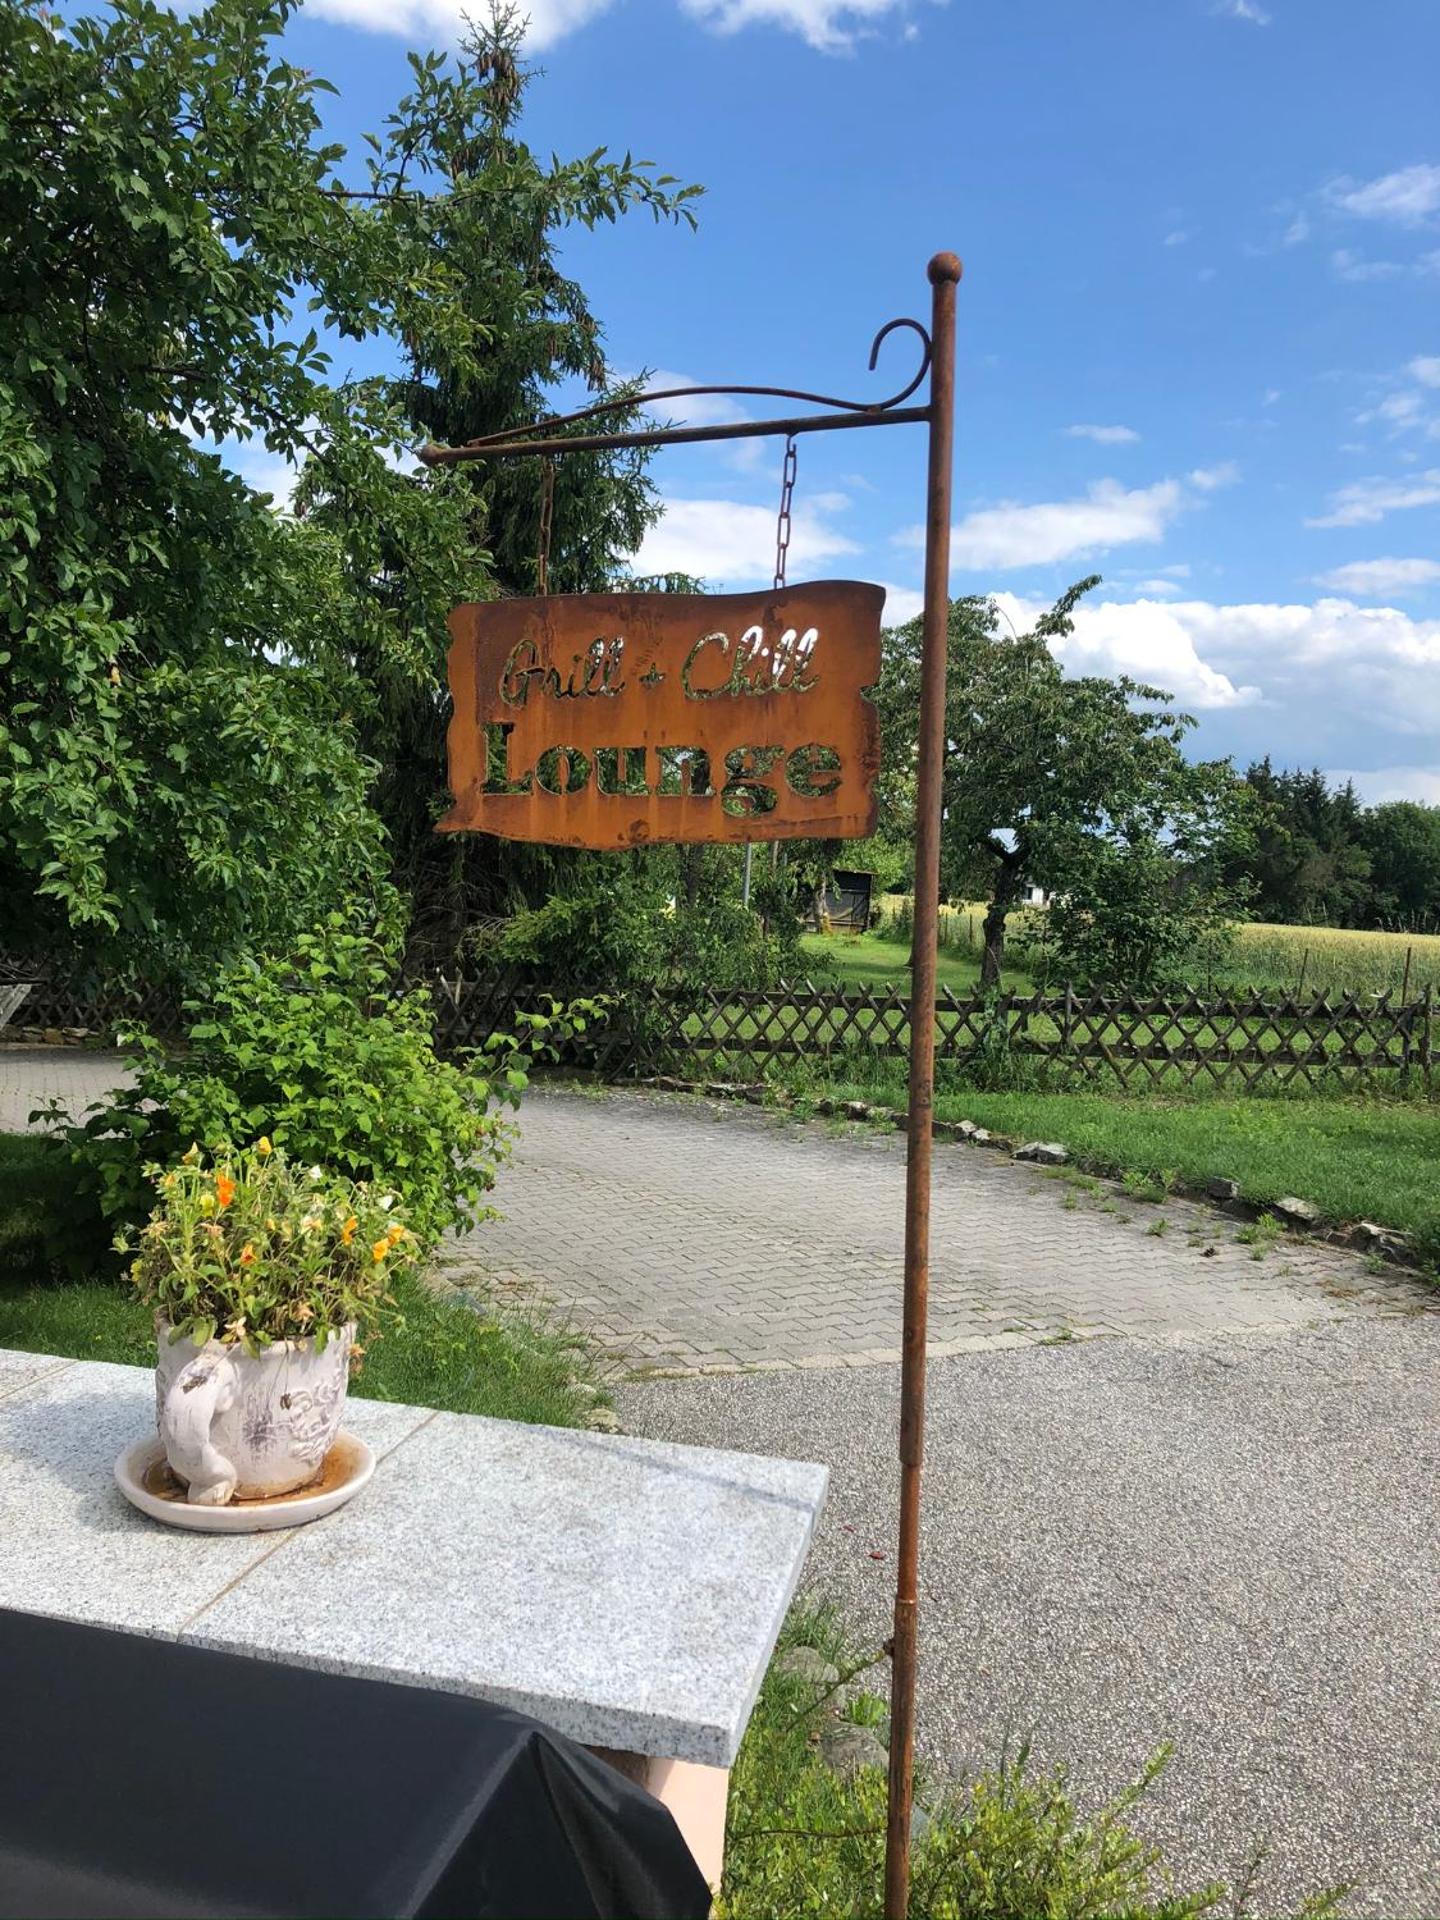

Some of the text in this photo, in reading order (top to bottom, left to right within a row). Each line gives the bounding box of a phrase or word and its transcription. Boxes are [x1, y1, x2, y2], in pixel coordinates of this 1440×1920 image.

[501, 635, 626, 710] Grill
[681, 625, 820, 700] Chill
[480, 721, 844, 818] Lounge
